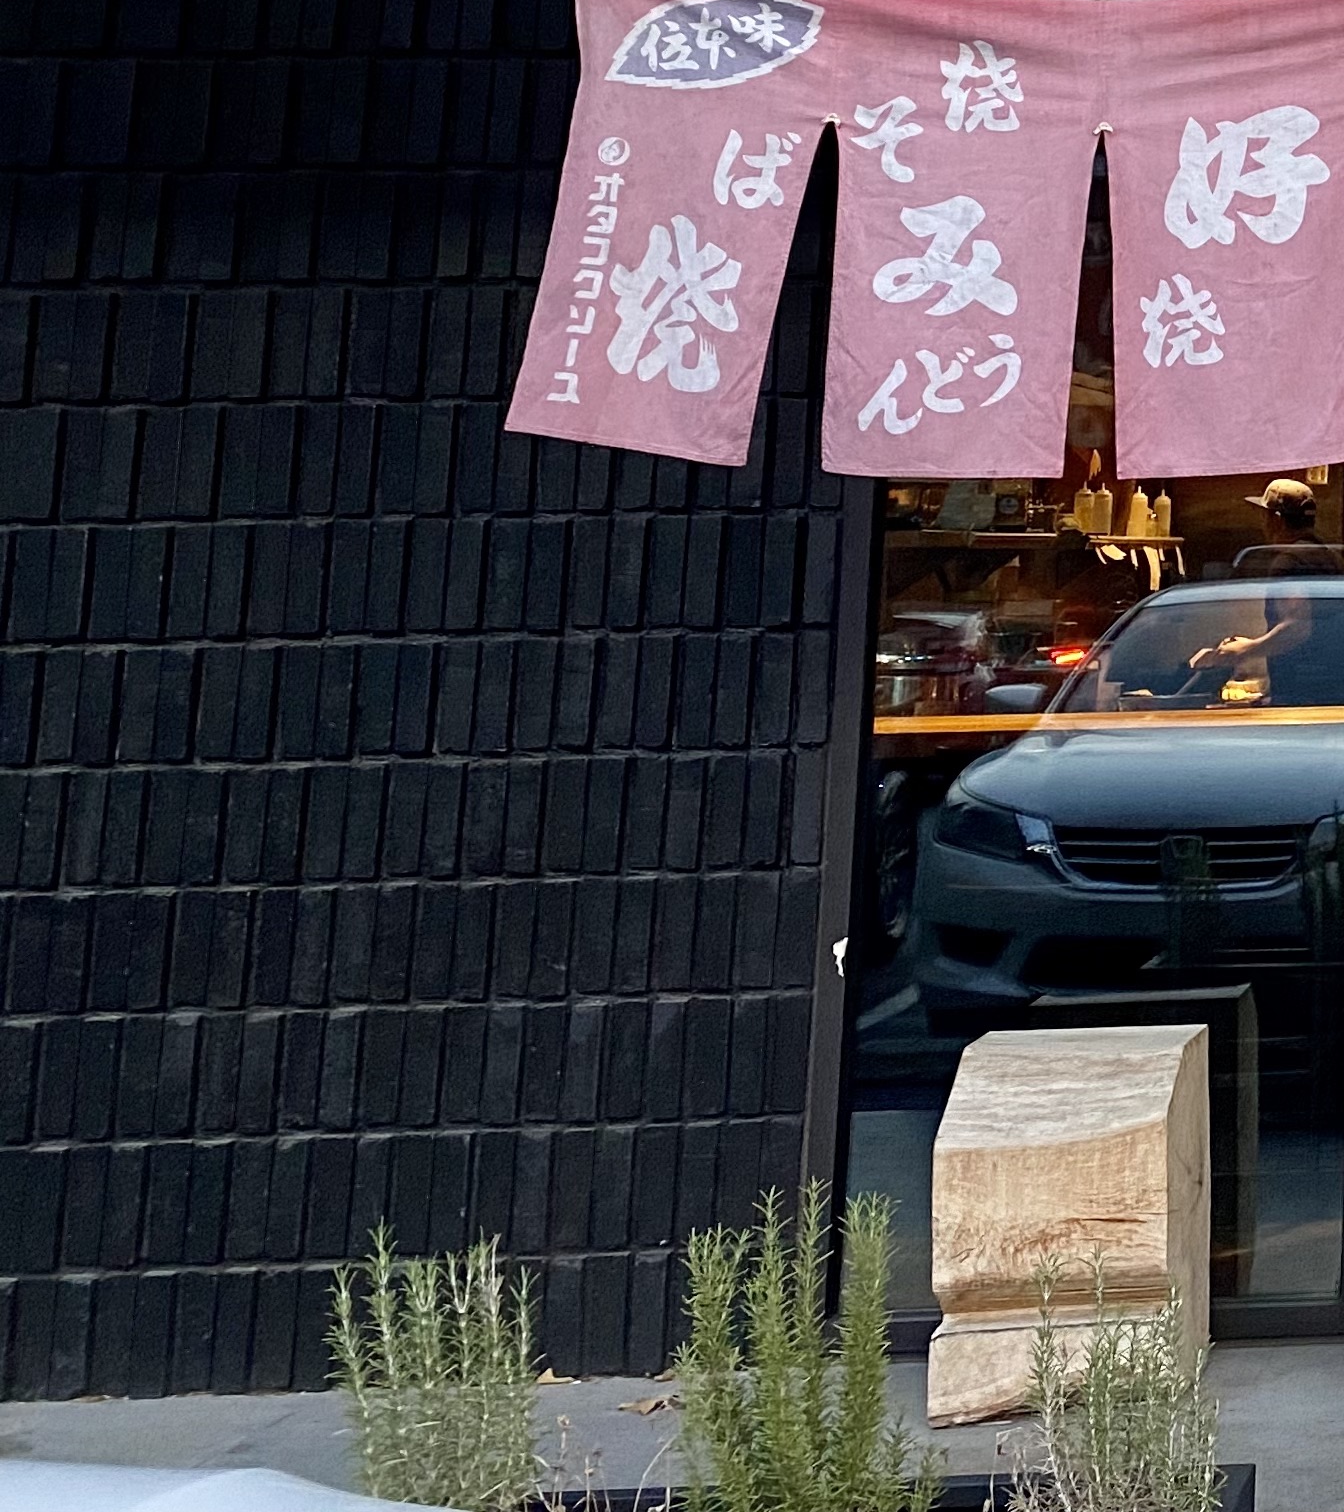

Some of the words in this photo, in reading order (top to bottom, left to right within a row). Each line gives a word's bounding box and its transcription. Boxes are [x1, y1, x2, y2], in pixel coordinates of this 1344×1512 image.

[546, 173, 625, 404] オタフクソース
